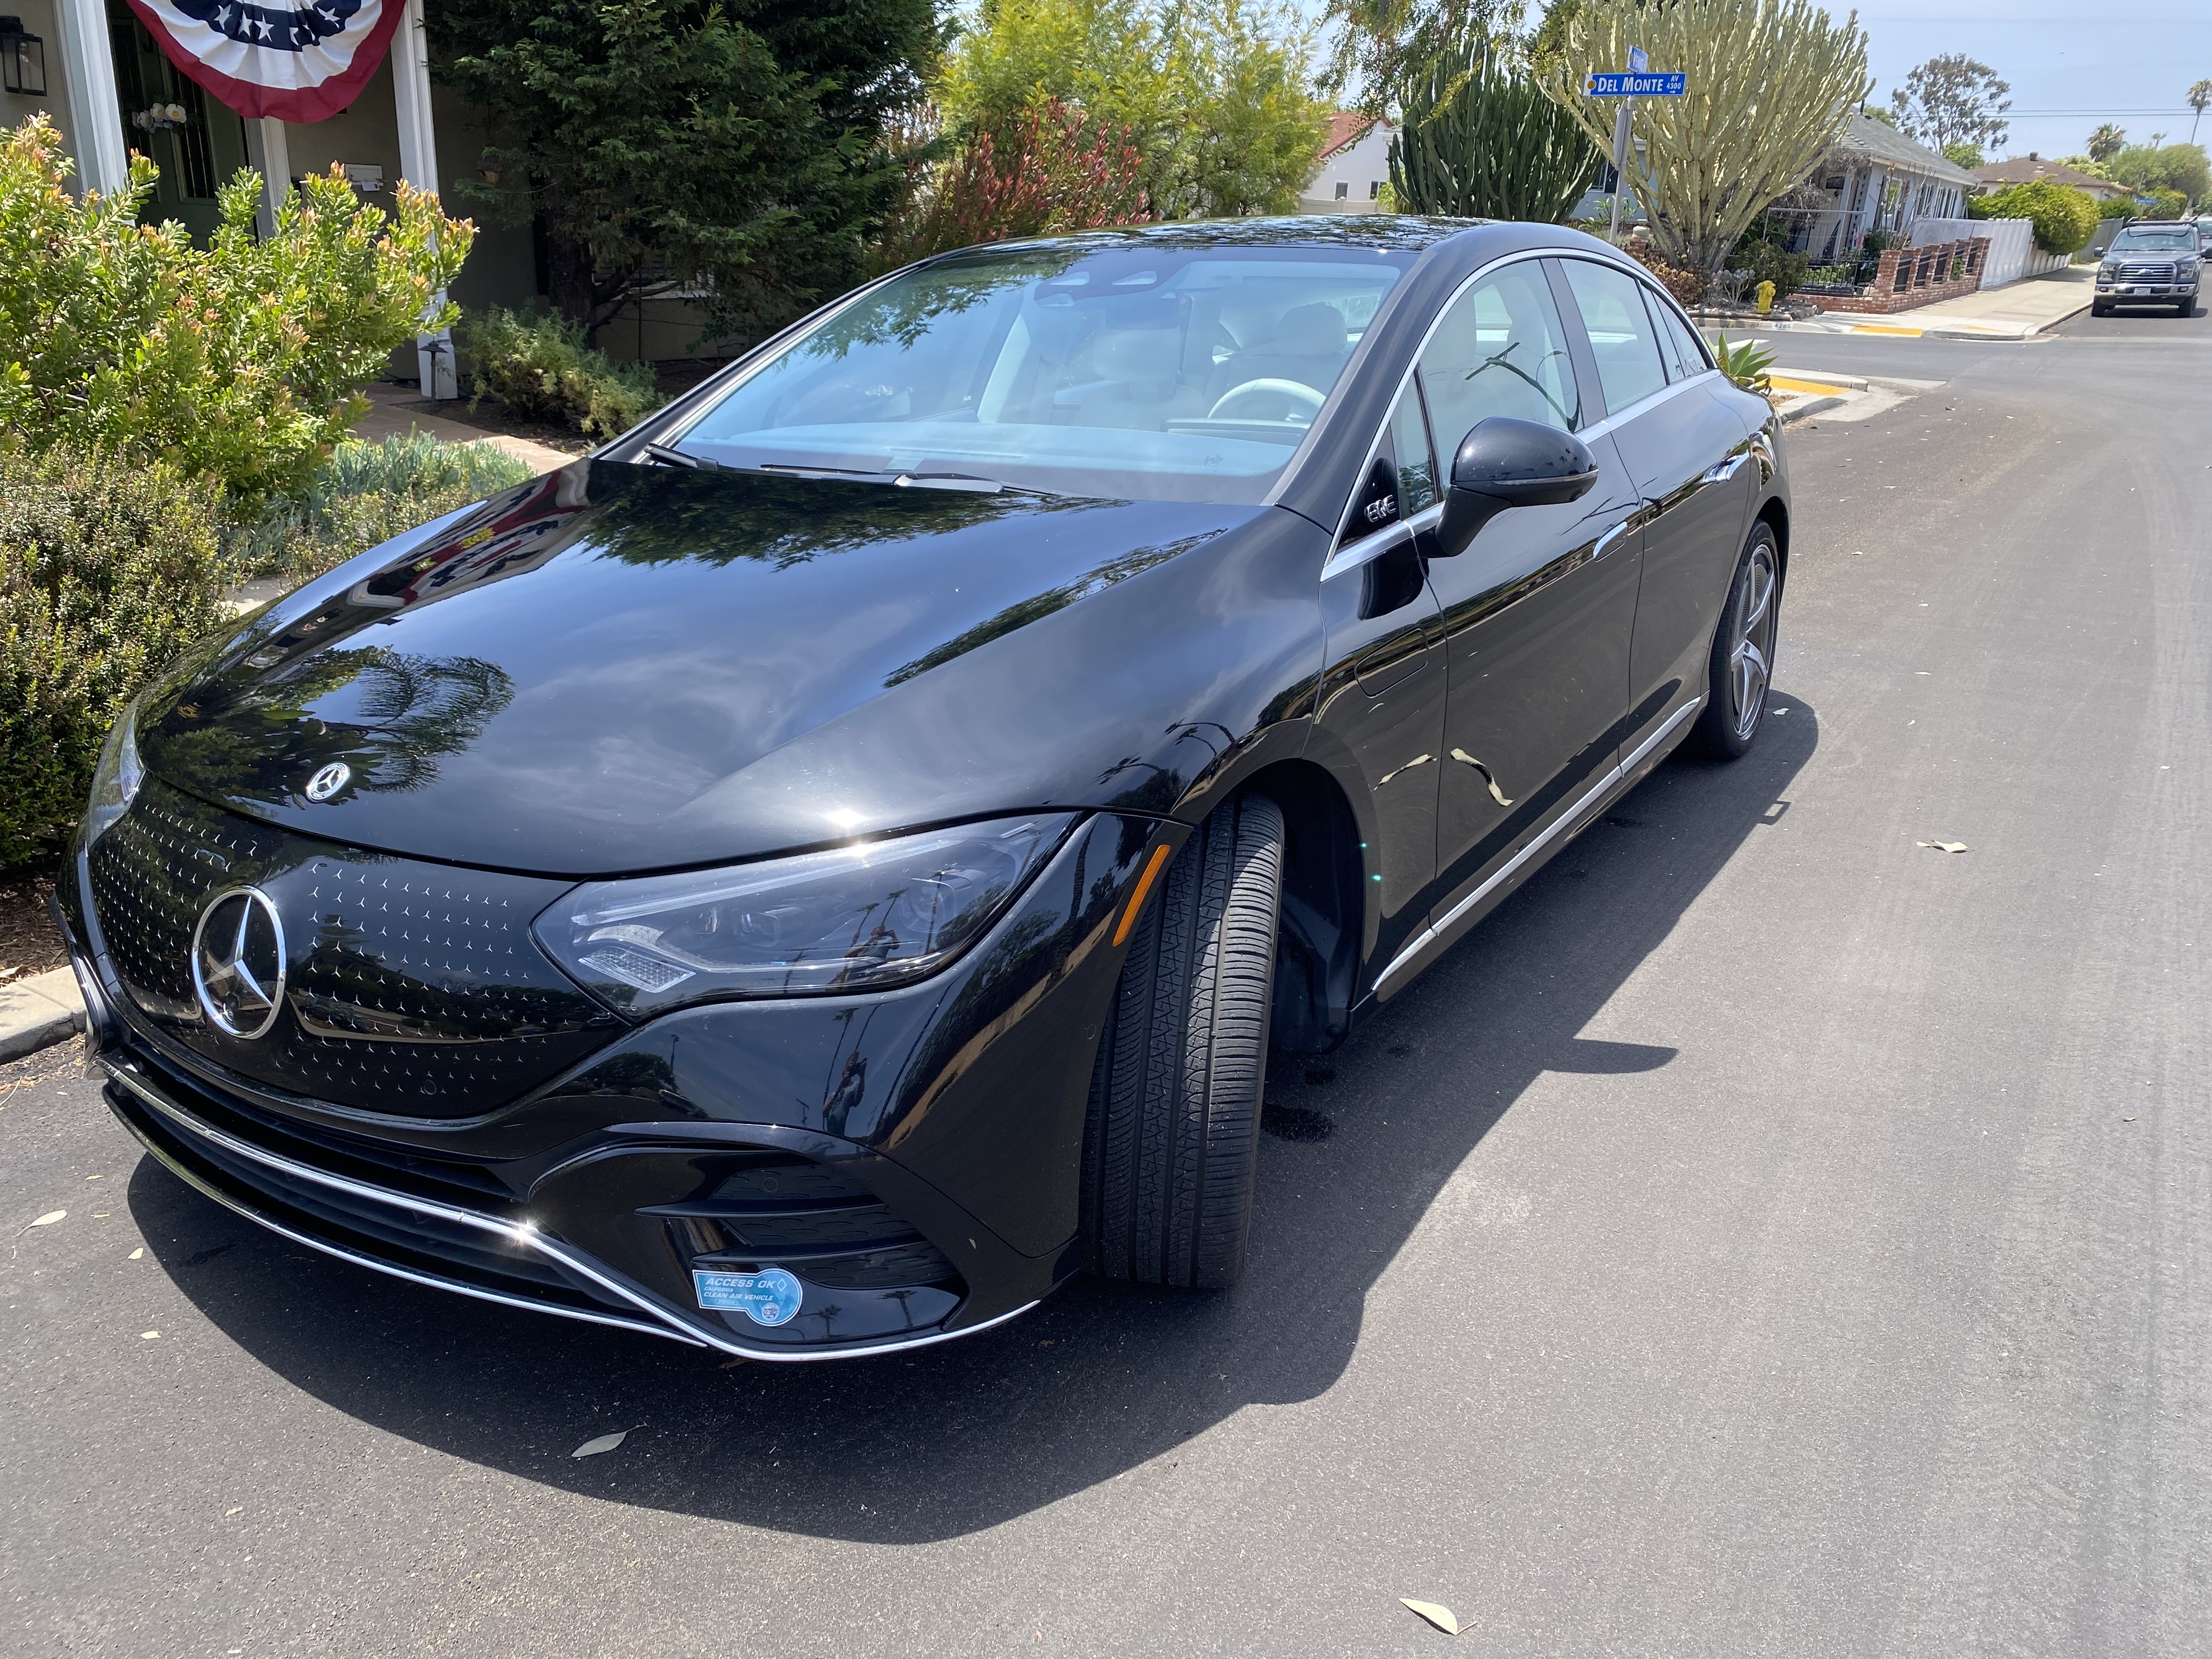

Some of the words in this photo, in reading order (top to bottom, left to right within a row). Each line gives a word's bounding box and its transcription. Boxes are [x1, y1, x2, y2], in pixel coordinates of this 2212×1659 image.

[1598, 77, 1618, 92] DEL
[1622, 77, 1664, 92] MONTE
[1364, 494, 1396, 522] EQE
[706, 1278, 754, 1288] ACCESS
